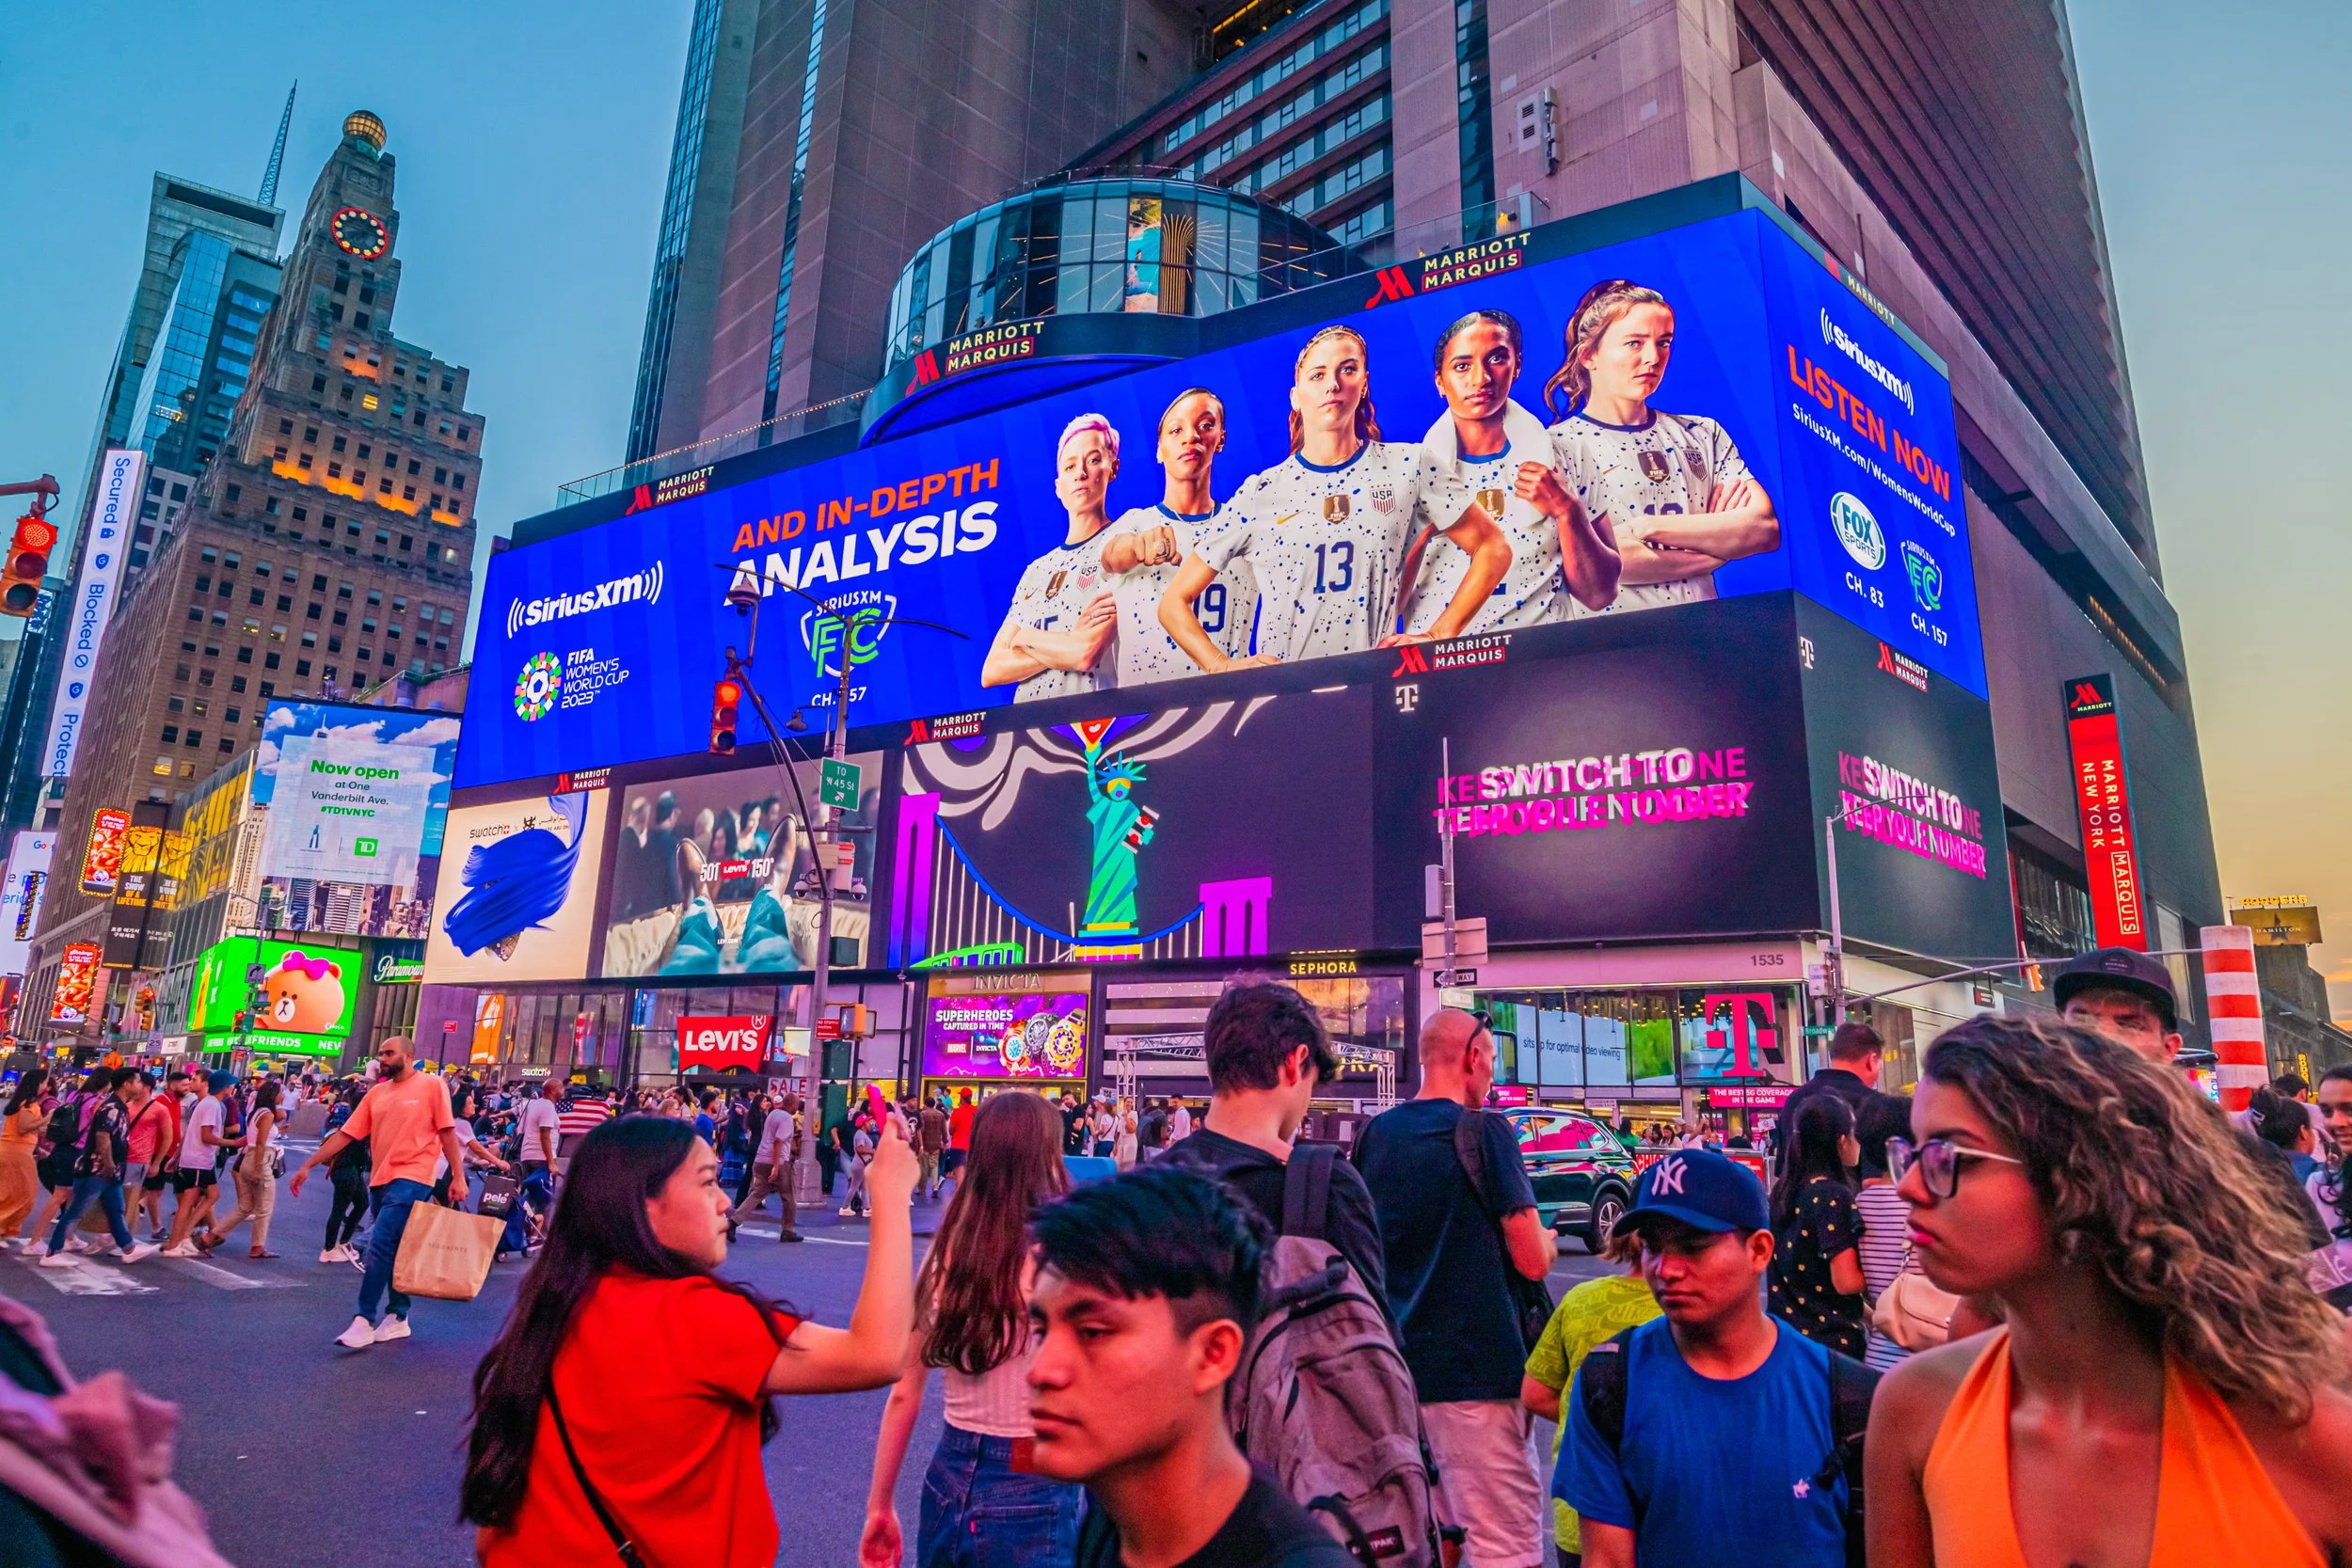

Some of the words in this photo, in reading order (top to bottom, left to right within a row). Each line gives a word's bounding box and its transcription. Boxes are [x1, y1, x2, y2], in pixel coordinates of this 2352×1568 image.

[1424, 232, 1531, 272] MARRIOTT
[1424, 253, 1518, 289] MARQUIS
[1848, 275, 1895, 325] MARRIOTT
[949, 321, 1044, 355] MARRIOTT
[948, 341, 1030, 372] MARQUIS
[1788, 343, 1886, 453] LISTEN
[1893, 430, 1949, 502] NOW
[659, 467, 714, 490] MARRIOTT
[1793, 402, 1956, 538] SiriusXM.com/WomensWorldCup
[103, 457, 130, 524] Secured
[657, 481, 706, 503] MARQUIS
[1371, 490, 1392, 501] USA
[731, 510, 805, 553] AND
[816, 458, 999, 531] IN-DEPTH
[1841, 501, 1874, 547] FOX
[723, 500, 999, 607] ANALYSIS
[1844, 531, 1877, 560] SPORTS
[1312, 540, 1354, 595] 13
[1845, 571, 1867, 597] CH.
[1869, 586, 1884, 608] 83
[1908, 553, 1941, 610] FC
[816, 591, 882, 617] SIRIUSXM
[77, 583, 104, 650] Blocked
[1911, 612, 1930, 637] CH.
[1931, 625, 1947, 646] 157
[811, 608, 882, 678] FC
[1435, 634, 1512, 656] MARRIOTT
[567, 648, 595, 666] FIFA
[1435, 649, 1502, 669] MARQUIS
[1895, 652, 1929, 679] MARRIOTT
[565, 658, 620, 680] WOMEN'S
[1896, 666, 1926, 689] MARQUIS
[564, 674, 604, 694] WORLD
[605, 670, 629, 686] CUP
[812, 691, 836, 705] CH.
[848, 687, 866, 702] 57
[2077, 702, 2112, 711] MARRIOTT
[933, 711, 986, 727] MARRIOTT
[932, 723, 979, 738] MARQUIS
[52, 713, 78, 778] Protect
[310, 759, 352, 776] Now
[354, 766, 400, 781] open
[574, 768, 611, 781] MARRIOTT
[836, 766, 847, 777] TO
[2082, 762, 2099, 797] NEW
[335, 781, 347, 789] at
[348, 781, 370, 791] One
[573, 778, 605, 790] MARQUIS
[826, 776, 834, 786] W
[834, 777, 846, 788] 45
[847, 781, 855, 791] St
[311, 791, 365, 803] Vanderbilt
[367, 796, 389, 806] Ave.
[320, 805, 375, 817] #TD1VNYC
[469, 824, 503, 839] swatch
[2088, 804, 2106, 848] YORK
[2101, 759, 2125, 847] MARRIOTT
[2114, 853, 2137, 933] MARQUIS
[2256, 926, 2301, 934] HAMILTON
[373, 955, 423, 982] Paramoun
[1290, 961, 1358, 975] SEPHORA
[1750, 954, 1784, 966] 1535
[973, 973, 1041, 990] INVICTA
[935, 1009, 1013, 1022] SUPERHEROES
[943, 1022, 978, 1031] CAPTURED
[987, 1022, 1005, 1030] TIME
[252, 1035, 302, 1048] FRIENDS
[946, 1043, 967, 1053] MARVEL
[1523, 1037, 1535, 1049] sits
[1546, 1040, 1556, 1052] for
[1556, 1042, 1581, 1054] optimal
[1598, 1046, 1621, 1060] viewing
[521, 1068, 547, 1077] swatch
[770, 1078, 807, 1094] SALE
